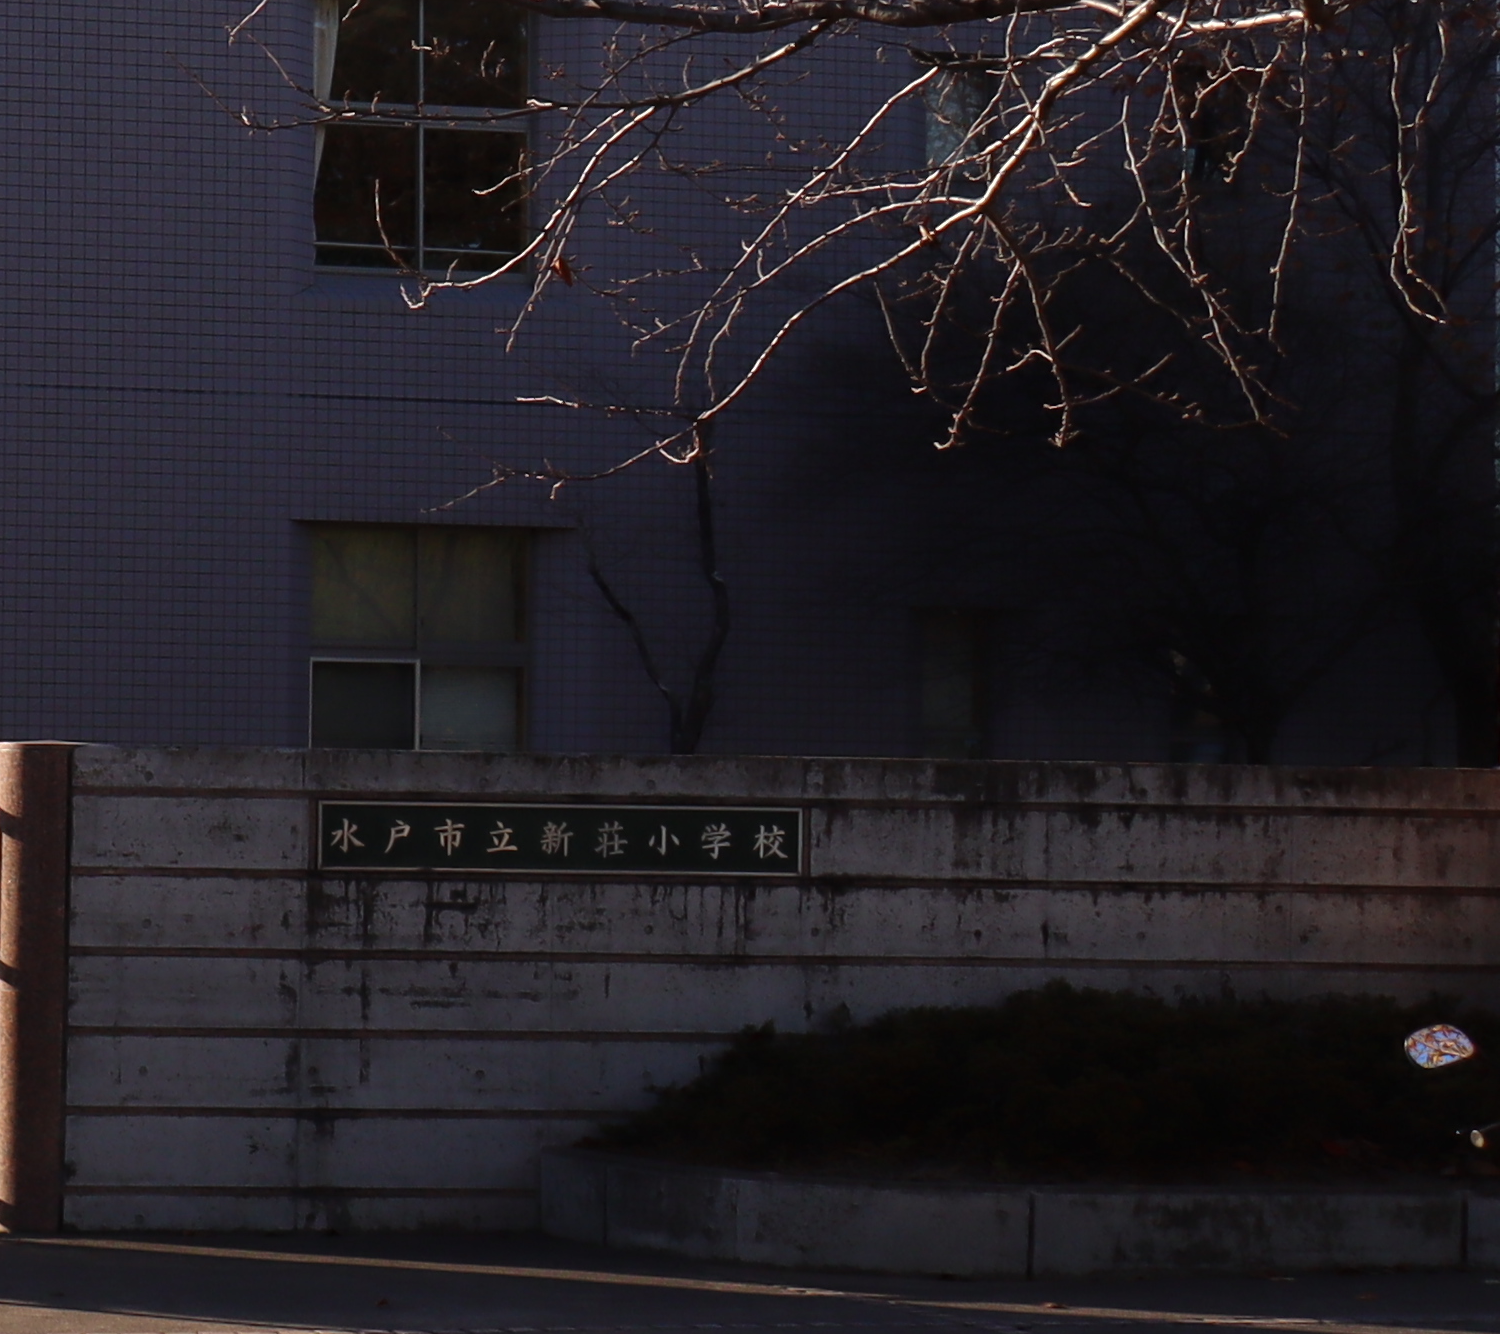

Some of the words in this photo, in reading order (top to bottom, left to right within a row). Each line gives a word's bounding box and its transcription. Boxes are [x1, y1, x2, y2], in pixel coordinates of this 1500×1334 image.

[330, 818, 788, 860] 水戸市立新荘小学校
